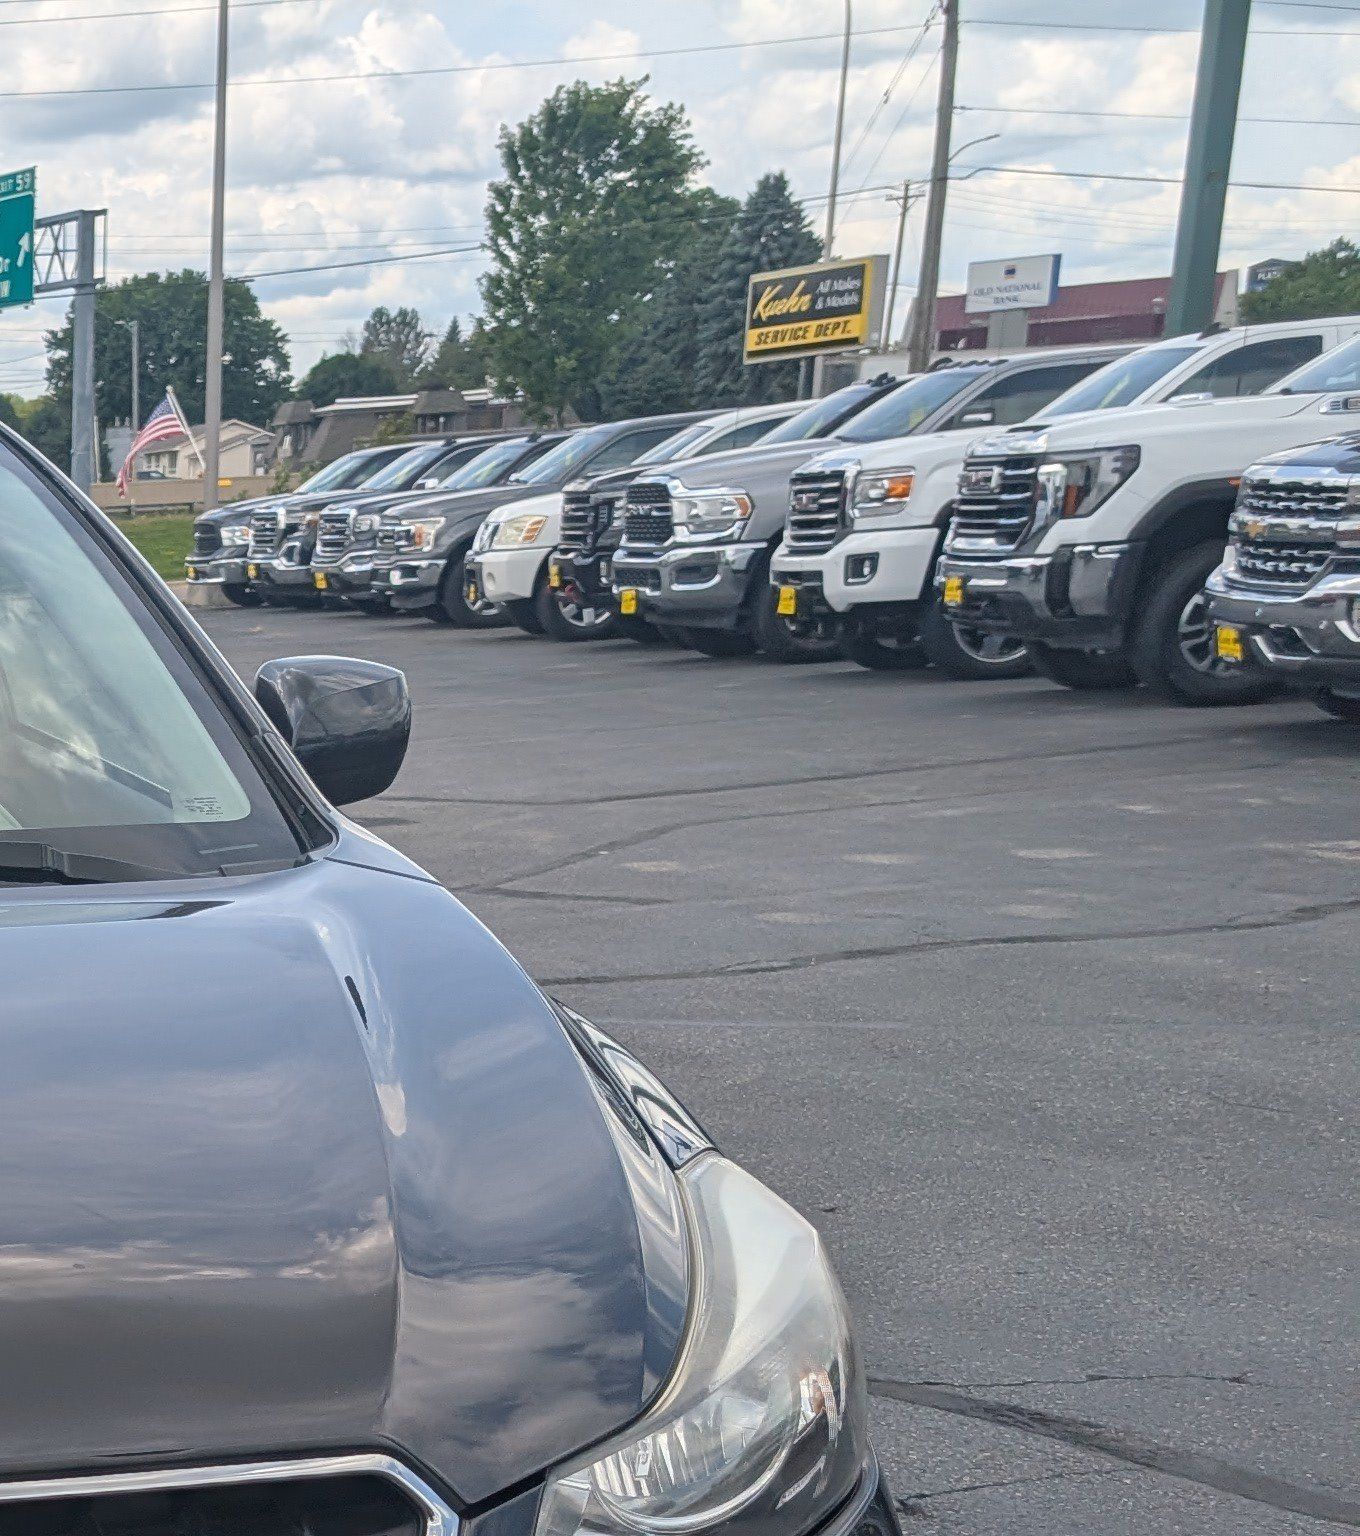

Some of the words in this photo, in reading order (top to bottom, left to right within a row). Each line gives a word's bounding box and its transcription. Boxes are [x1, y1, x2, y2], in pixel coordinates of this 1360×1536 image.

[15, 172, 32, 191] 59
[752, 280, 813, 321] Kuehn
[754, 325, 810, 346] SERVICE
[813, 319, 852, 339] DEPT.
